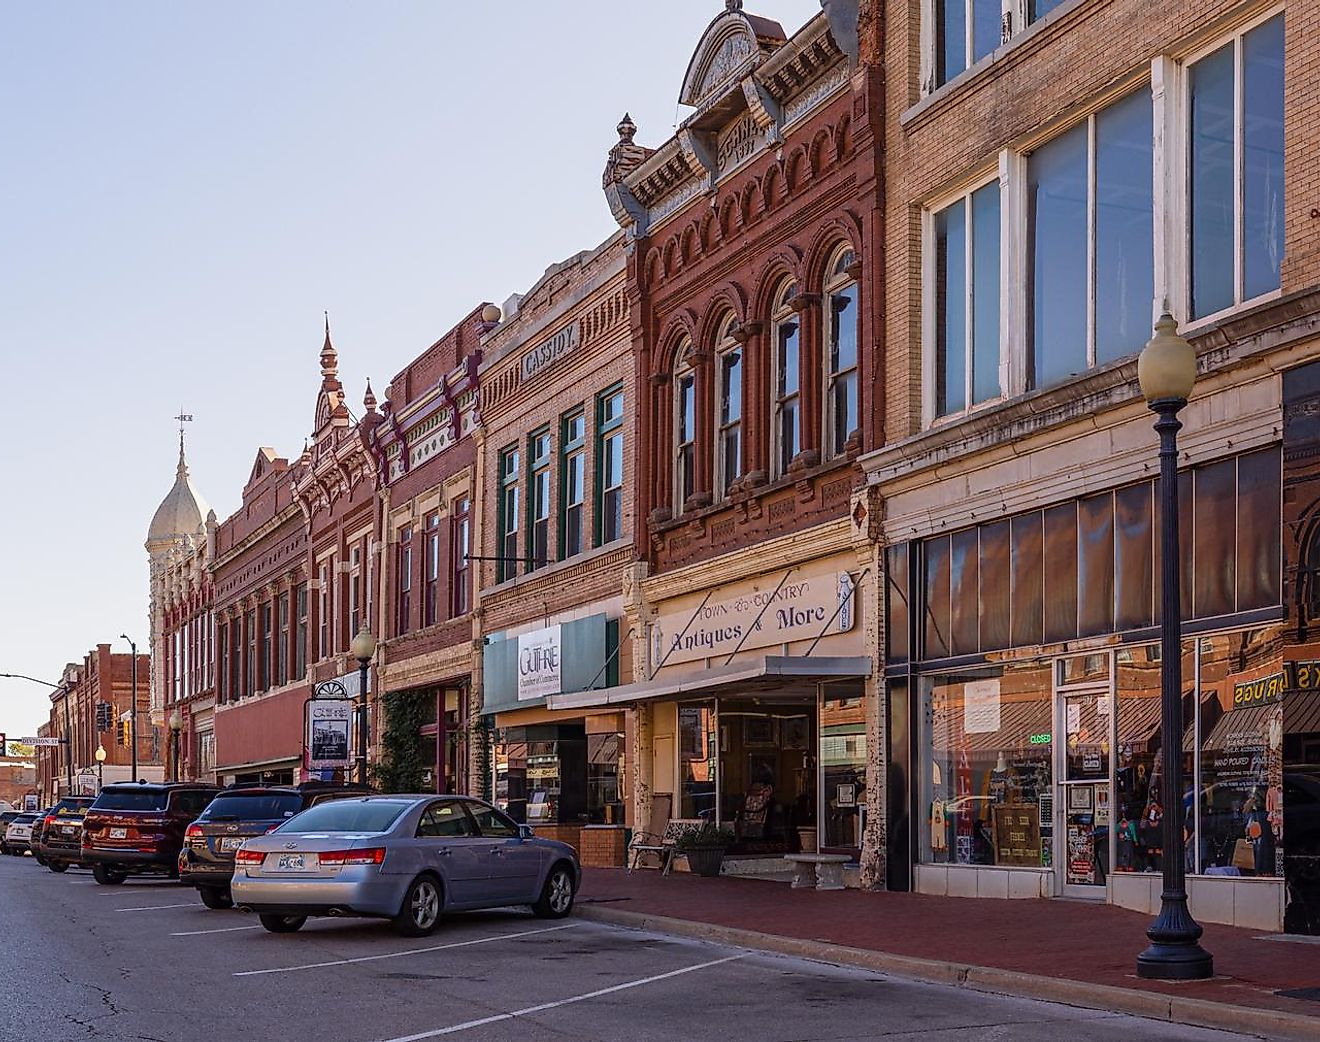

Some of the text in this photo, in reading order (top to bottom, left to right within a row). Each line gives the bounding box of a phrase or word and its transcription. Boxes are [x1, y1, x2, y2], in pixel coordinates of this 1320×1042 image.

[525, 325, 575, 375] CASSIDY.
[671, 624, 742, 651] Antiques
[776, 605, 826, 630] More
[520, 644, 559, 676] GUTHRIE
[1030, 734, 1052, 744] CLOSED
